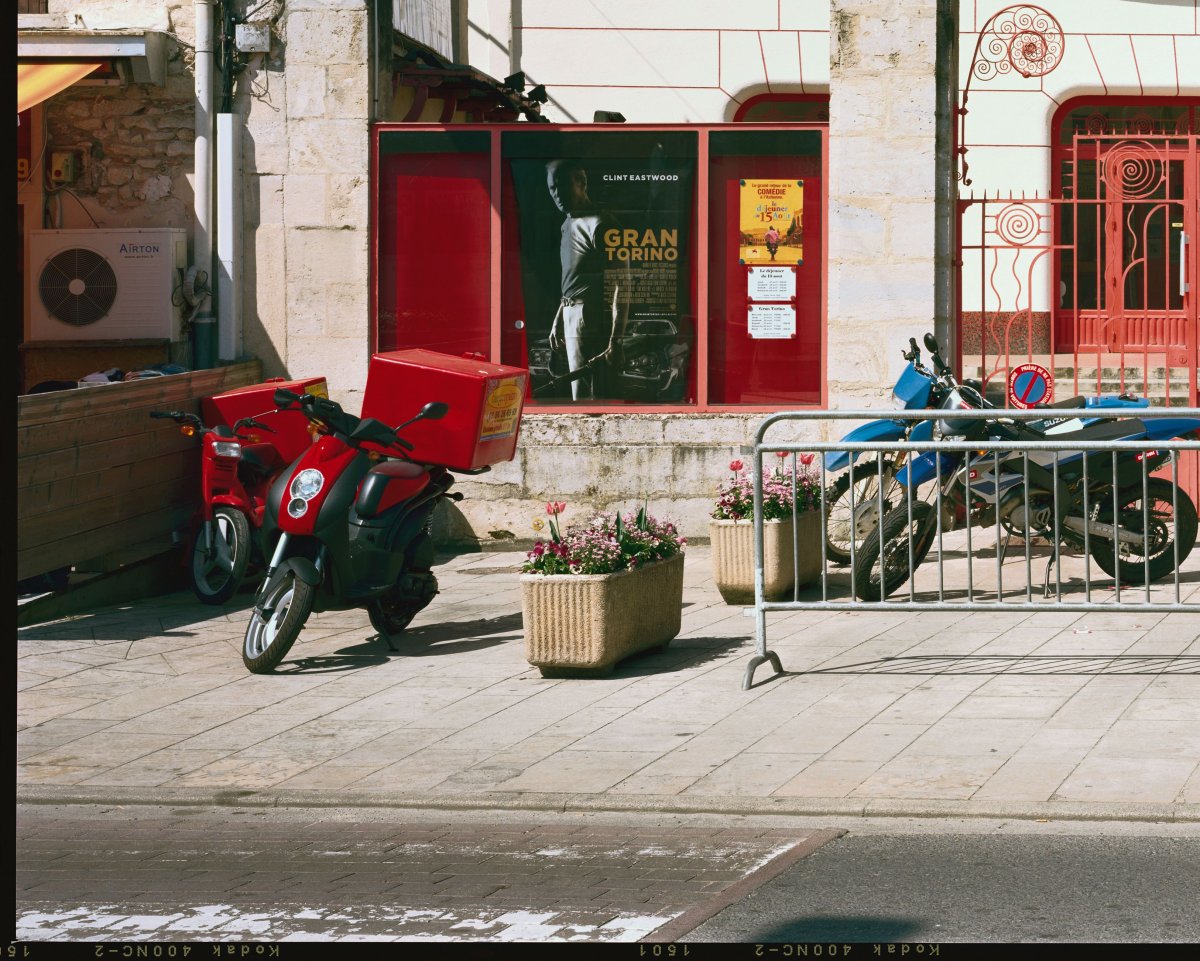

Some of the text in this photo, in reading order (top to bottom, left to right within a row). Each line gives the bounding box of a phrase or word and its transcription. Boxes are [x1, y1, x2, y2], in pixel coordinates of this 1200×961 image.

[760, 212, 773, 222] 15
[603, 228, 678, 247] GRAN
[604, 247, 679, 261] TORINO
[94, 945, 192, 957] 400NC-2
[212, 945, 280, 957] Kodak
[639, 944, 941, 956] Kodak 400NC-2 1501
